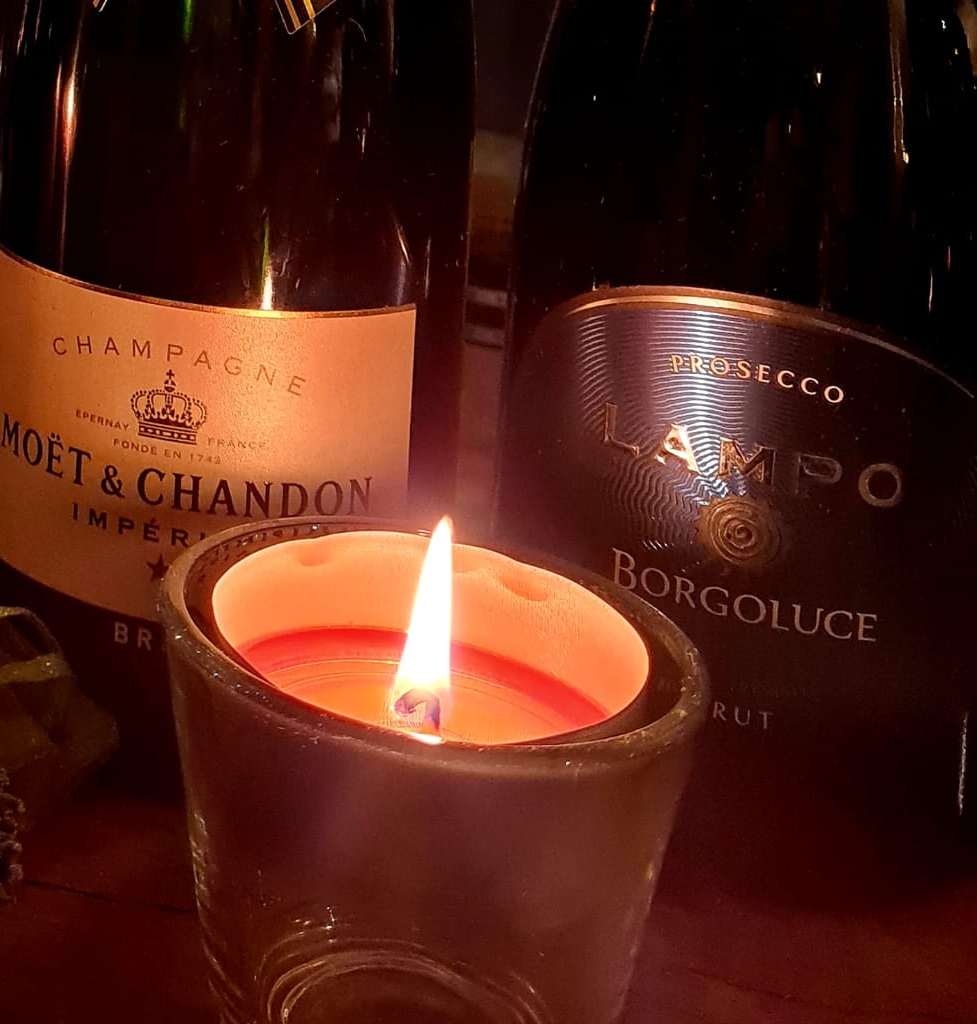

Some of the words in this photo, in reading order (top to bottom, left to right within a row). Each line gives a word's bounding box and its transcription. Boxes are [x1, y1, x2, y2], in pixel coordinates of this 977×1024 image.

[53, 336, 306, 397] CHAMPAGNE
[670, 354, 845, 404] PROSECCO
[1, 413, 92, 487] MOËT
[100, 465, 126, 498] &
[137, 467, 373, 519] CHANDON
[164, 448, 182, 458] EN
[602, 402, 903, 508] LAMPO
